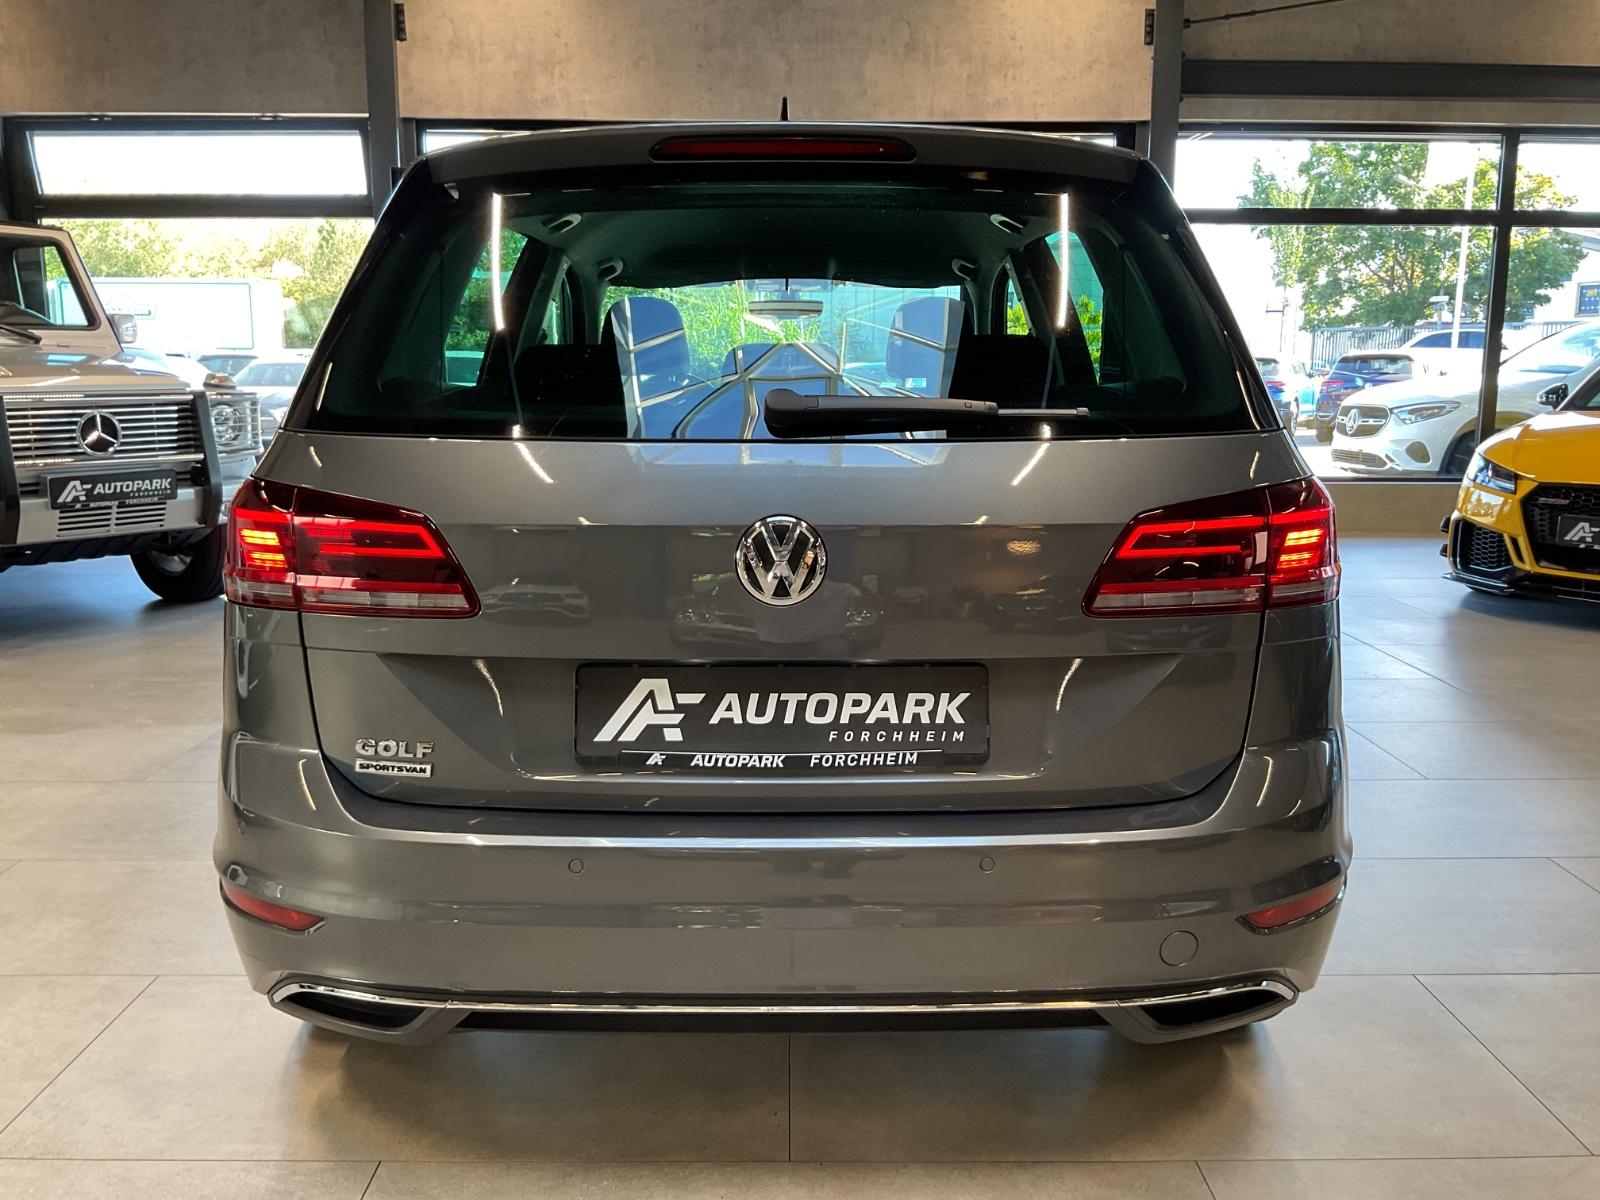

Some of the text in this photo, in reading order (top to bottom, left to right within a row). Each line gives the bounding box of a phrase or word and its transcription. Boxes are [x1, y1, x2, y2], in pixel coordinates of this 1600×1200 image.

[93, 478, 172, 494] AUTOPARK
[708, 692, 972, 725] AUTOPARK
[828, 730, 966, 742] FORCHHEIM
[355, 738, 434, 758] GOLF
[690, 754, 786, 768] AUTOPARK
[809, 751, 918, 768] FORCHHEIM
[358, 762, 427, 774] SPORTSVAN
